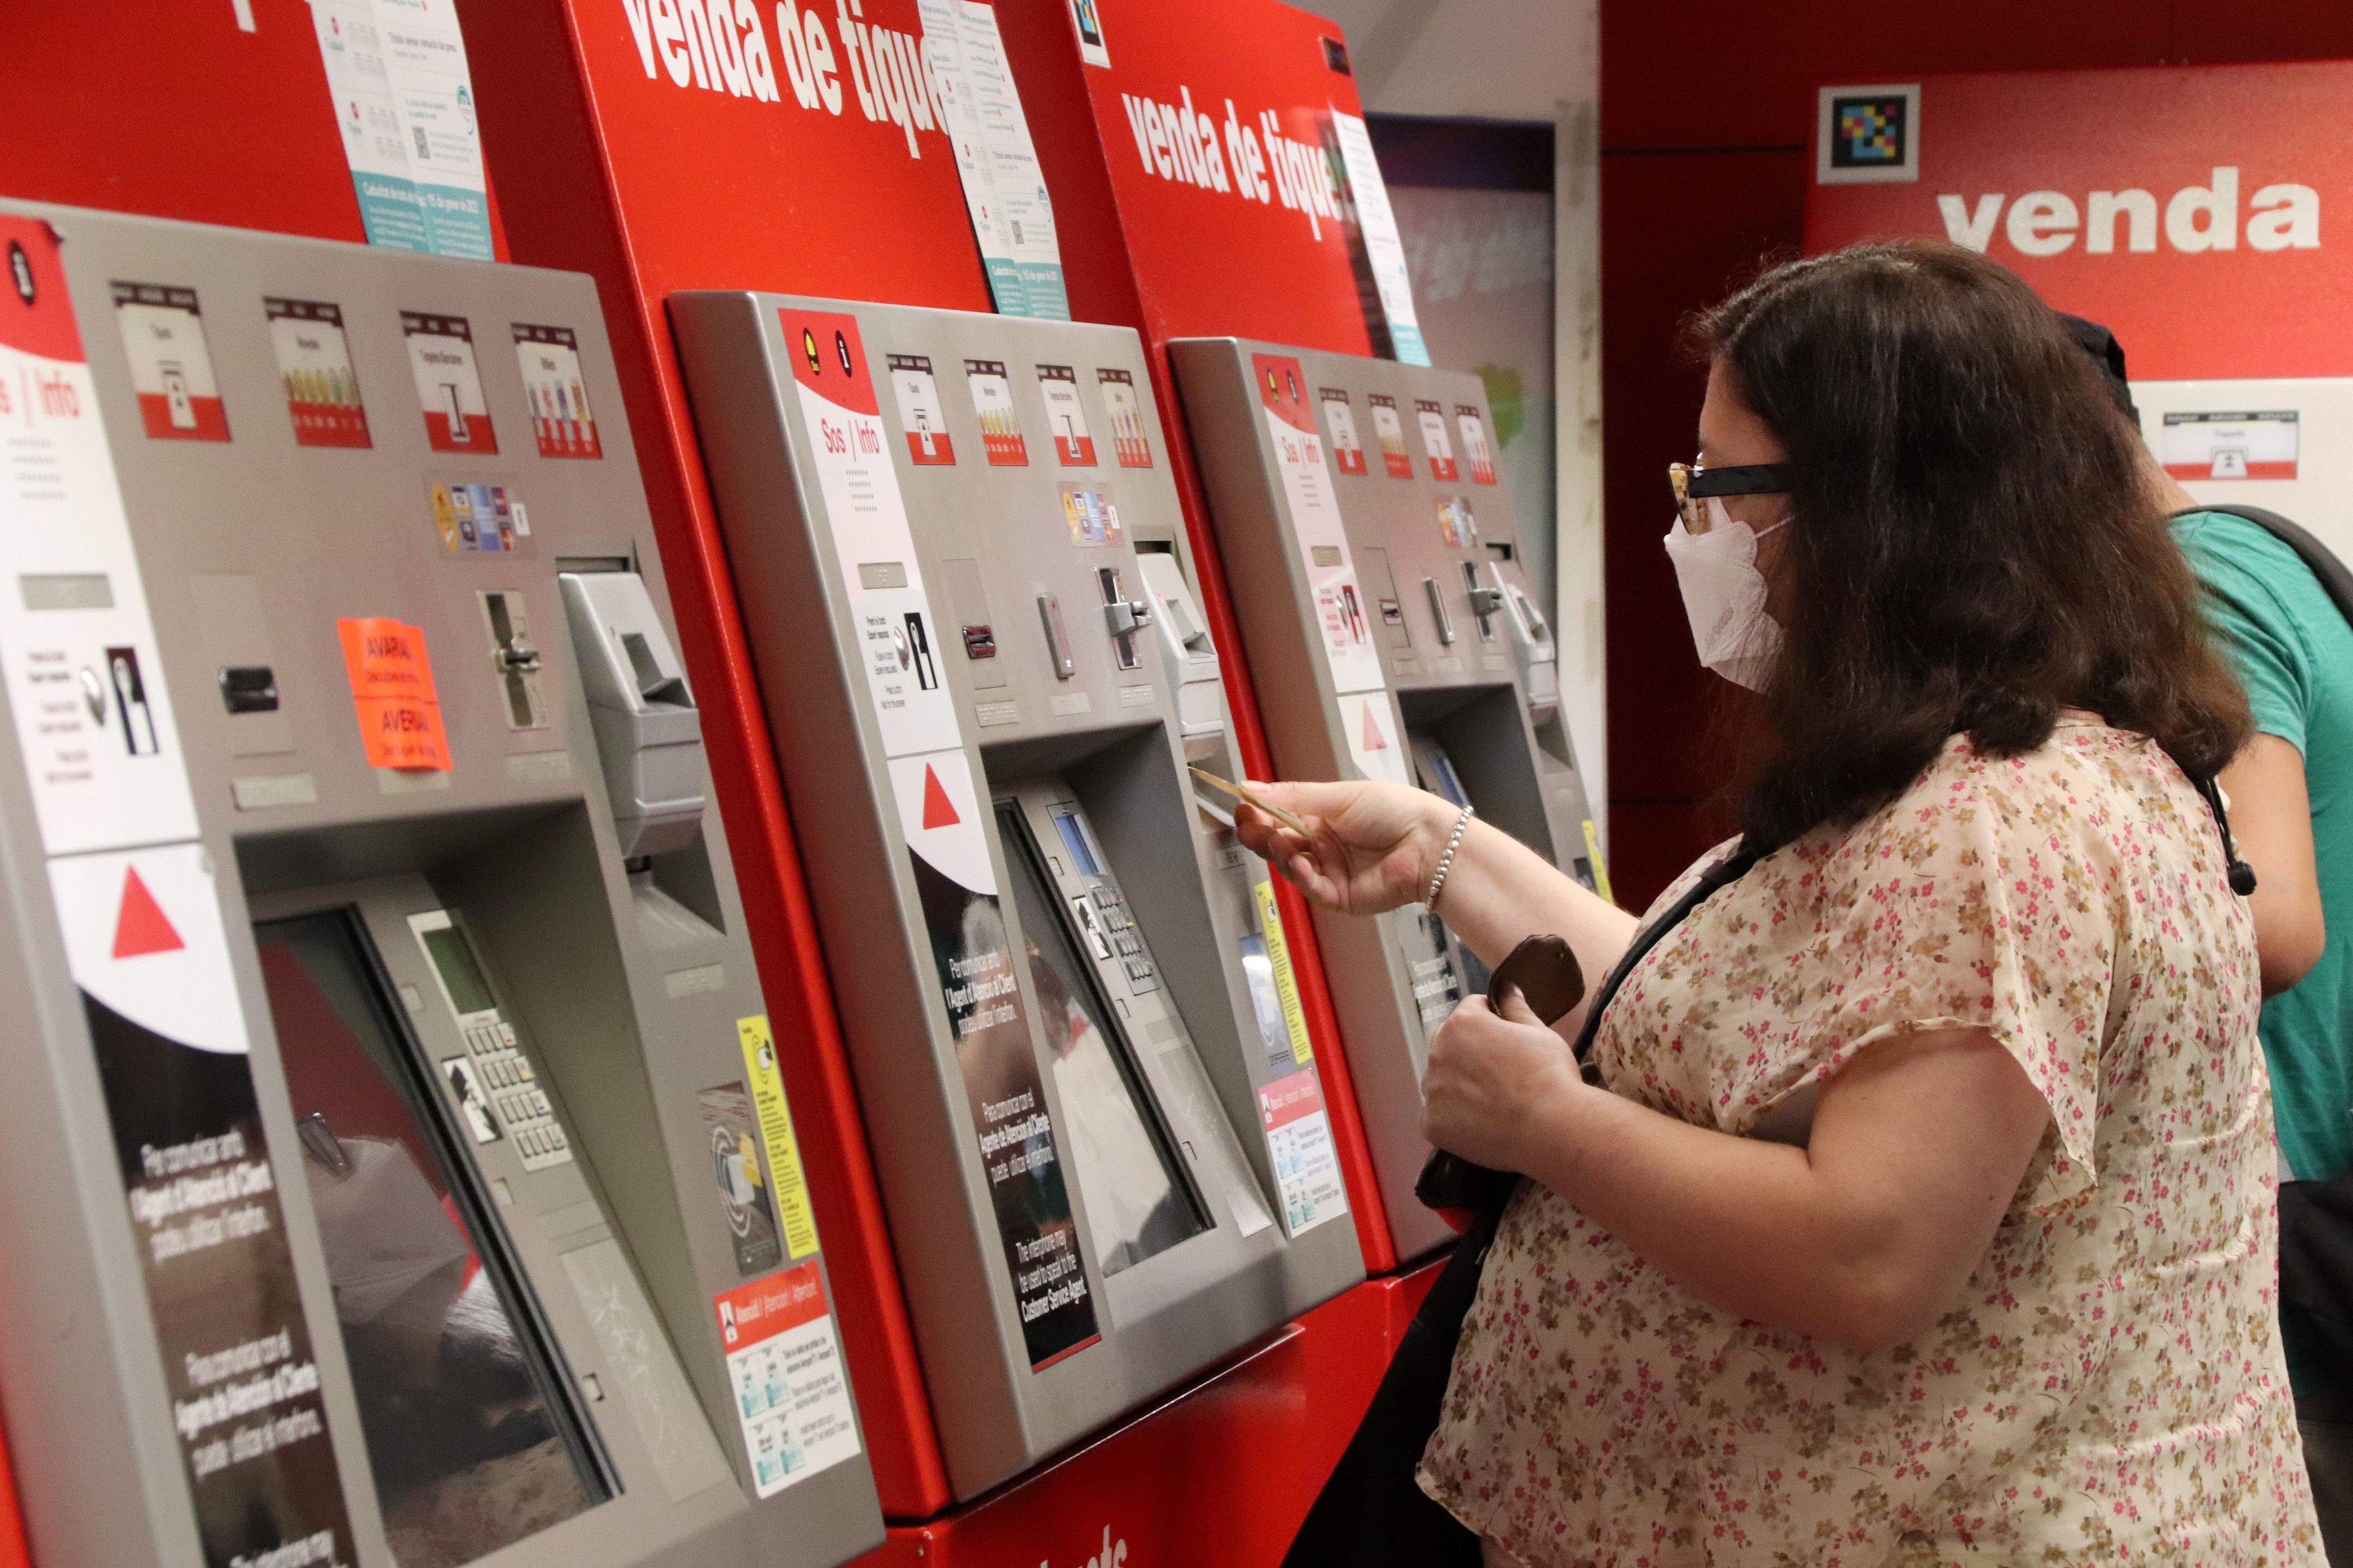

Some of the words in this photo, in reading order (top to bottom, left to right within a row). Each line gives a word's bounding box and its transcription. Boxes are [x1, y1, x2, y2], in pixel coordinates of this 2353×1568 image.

[622, 0, 781, 102] venda
[776, 0, 843, 116] de
[1121, 84, 1231, 194] venda
[1224, 98, 1271, 204] de
[1937, 166, 2321, 257] venda
[821, 417, 846, 454] Sos
[854, 419, 880, 454] Info
[1281, 436, 1299, 463] Sos
[1303, 438, 1320, 464] Info
[979, 1131, 1000, 1158] Agente
[997, 1127, 1007, 1147] de
[1030, 1112, 1050, 1135] Cliente
[1015, 1241, 1029, 1262] The
[1018, 1273, 1028, 1293] be
[1021, 1296, 1049, 1322] Customer
[1047, 1284, 1070, 1309] Service
[1067, 1276, 1087, 1304] Agent.
